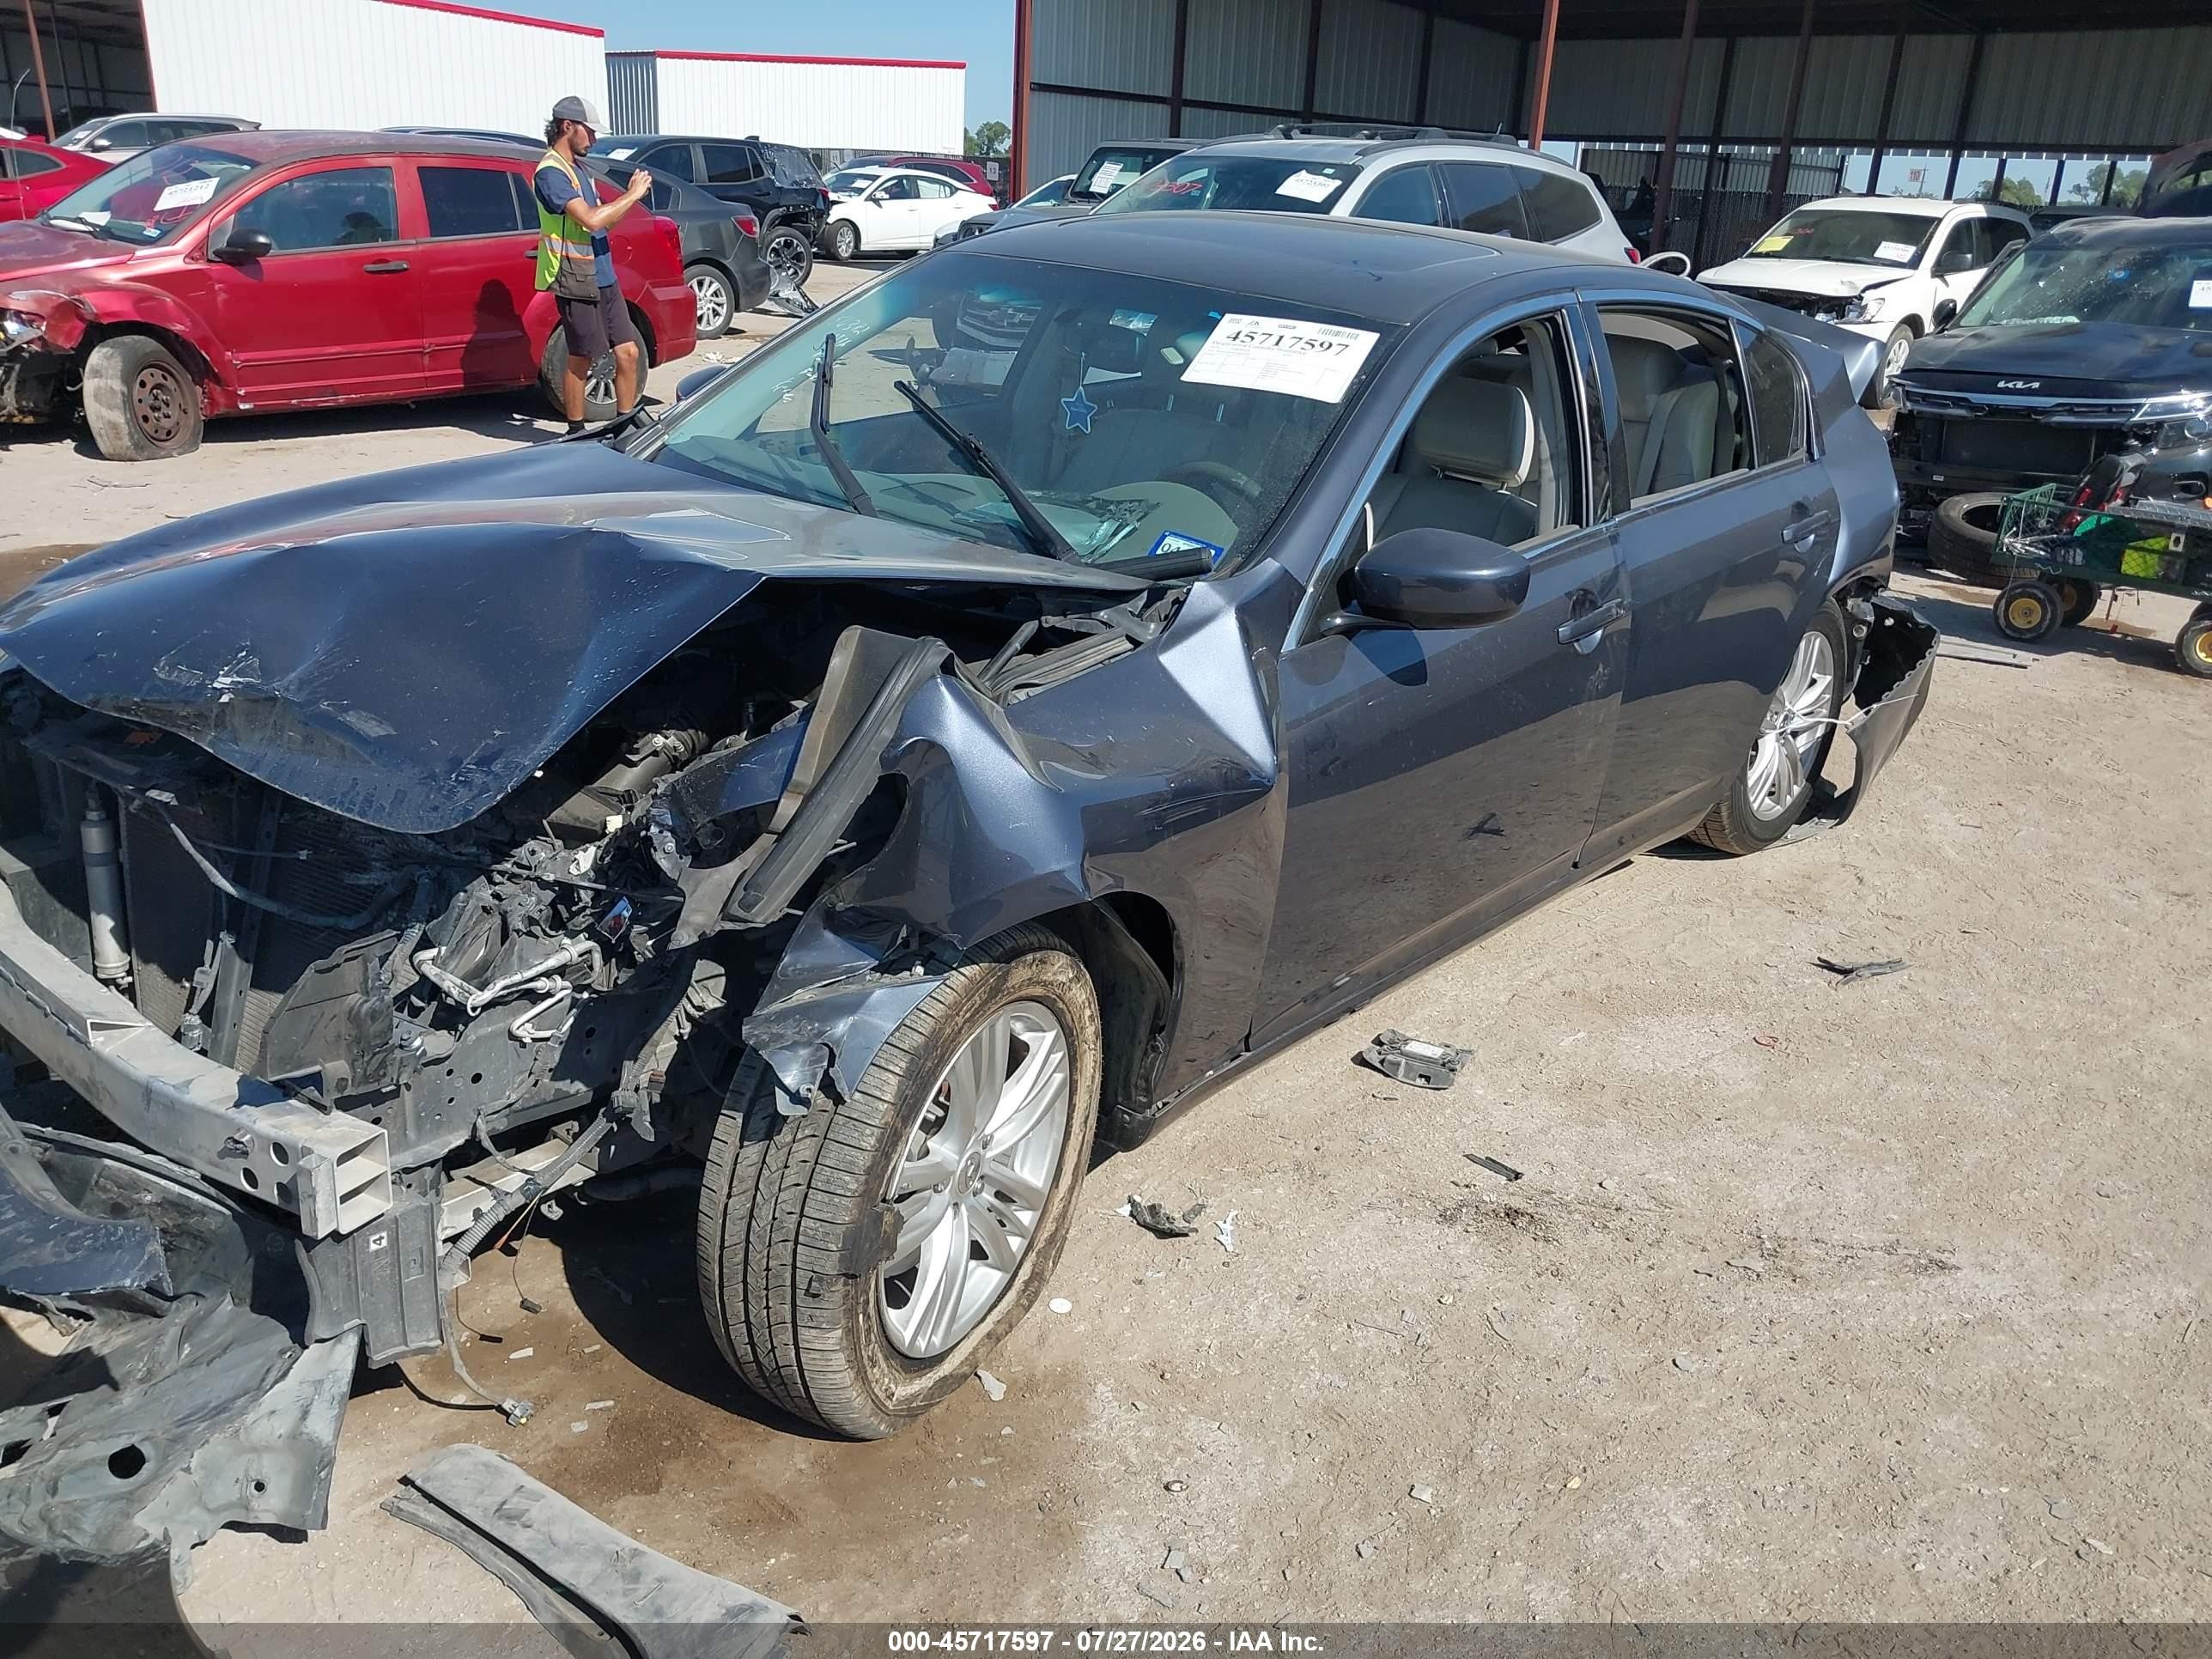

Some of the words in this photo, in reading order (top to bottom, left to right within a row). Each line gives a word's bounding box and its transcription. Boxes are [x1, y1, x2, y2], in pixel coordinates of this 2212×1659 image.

[1910, 170, 1921, 181] 110
[1225, 330, 1350, 356] 45717597
[372, 1235, 386, 1247] 4
